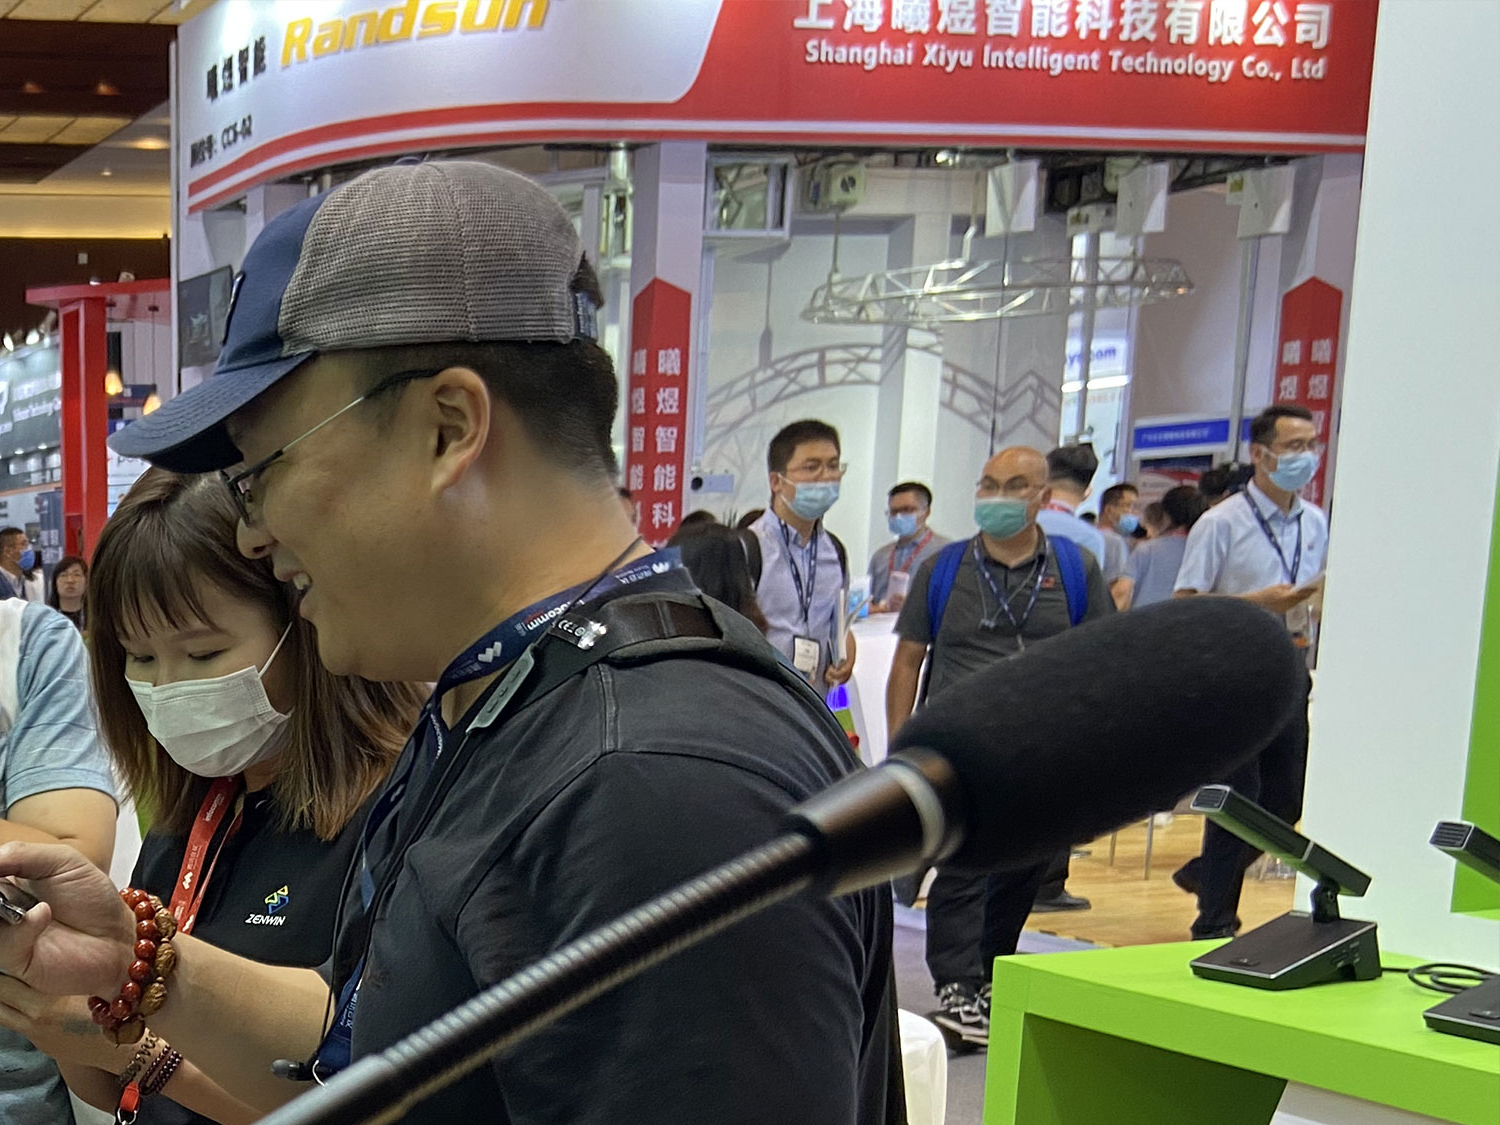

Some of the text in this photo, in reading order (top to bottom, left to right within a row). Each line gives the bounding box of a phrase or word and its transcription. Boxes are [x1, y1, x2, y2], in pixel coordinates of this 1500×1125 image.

[281, 0, 550, 68] Randsun
[805, 39, 1326, 82] Shanghai Xiyu Intelligent Technology Co., Ltd
[652, 347, 682, 547] 曦煜智能科
[245, 913, 286, 926] ZENWIN
